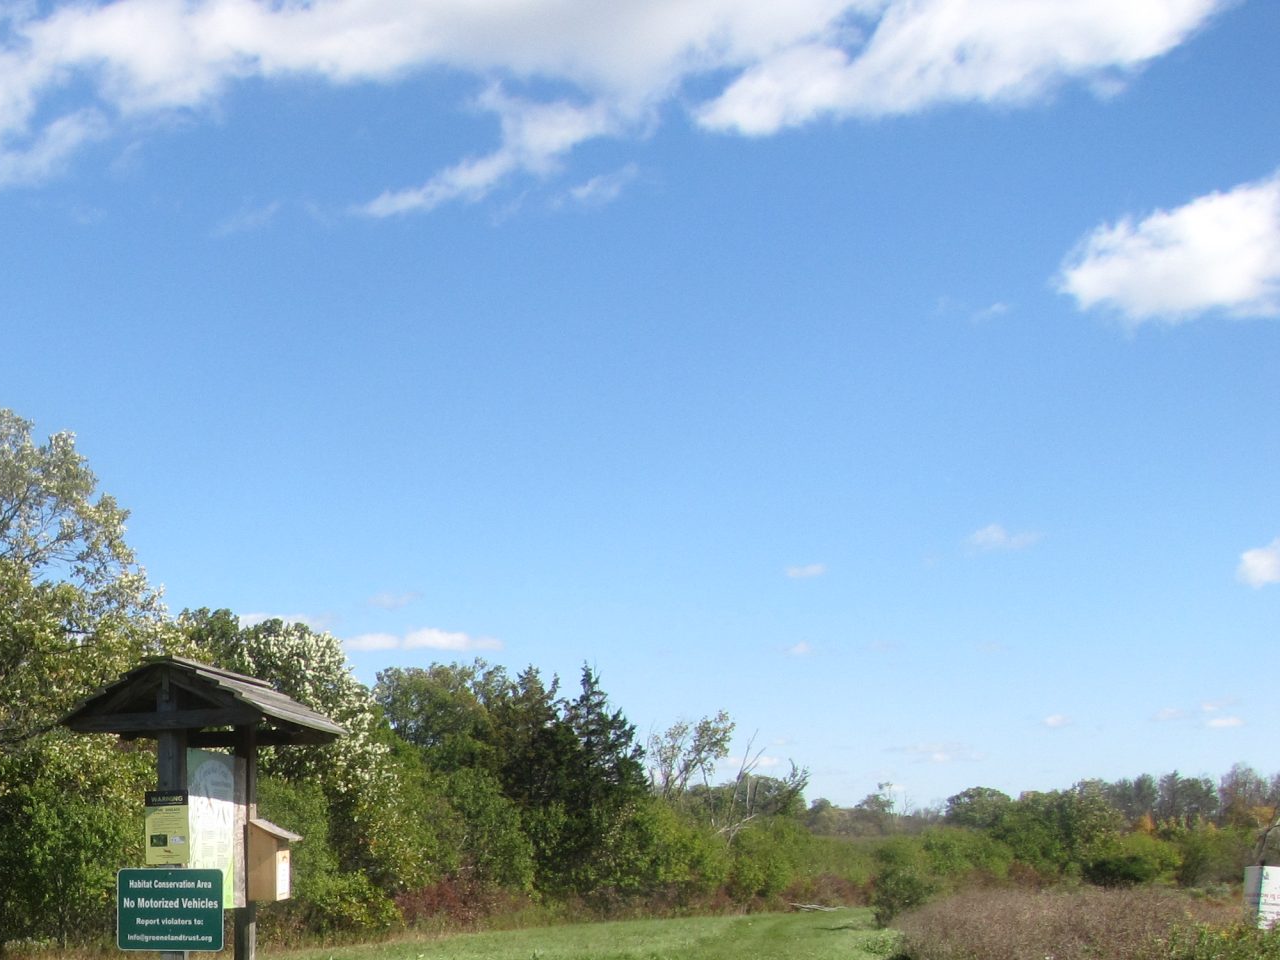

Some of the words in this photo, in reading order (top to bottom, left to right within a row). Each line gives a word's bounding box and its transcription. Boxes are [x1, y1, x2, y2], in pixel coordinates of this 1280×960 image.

[129, 880, 152, 889] Habitat
[154, 880, 195, 889] Conservation
[196, 880, 212, 889] Area
[123, 897, 135, 908] No
[137, 897, 179, 908] Motorized
[181, 897, 218, 908] Vehicles
[136, 918, 160, 926] Report
[161, 917, 192, 925] violators
